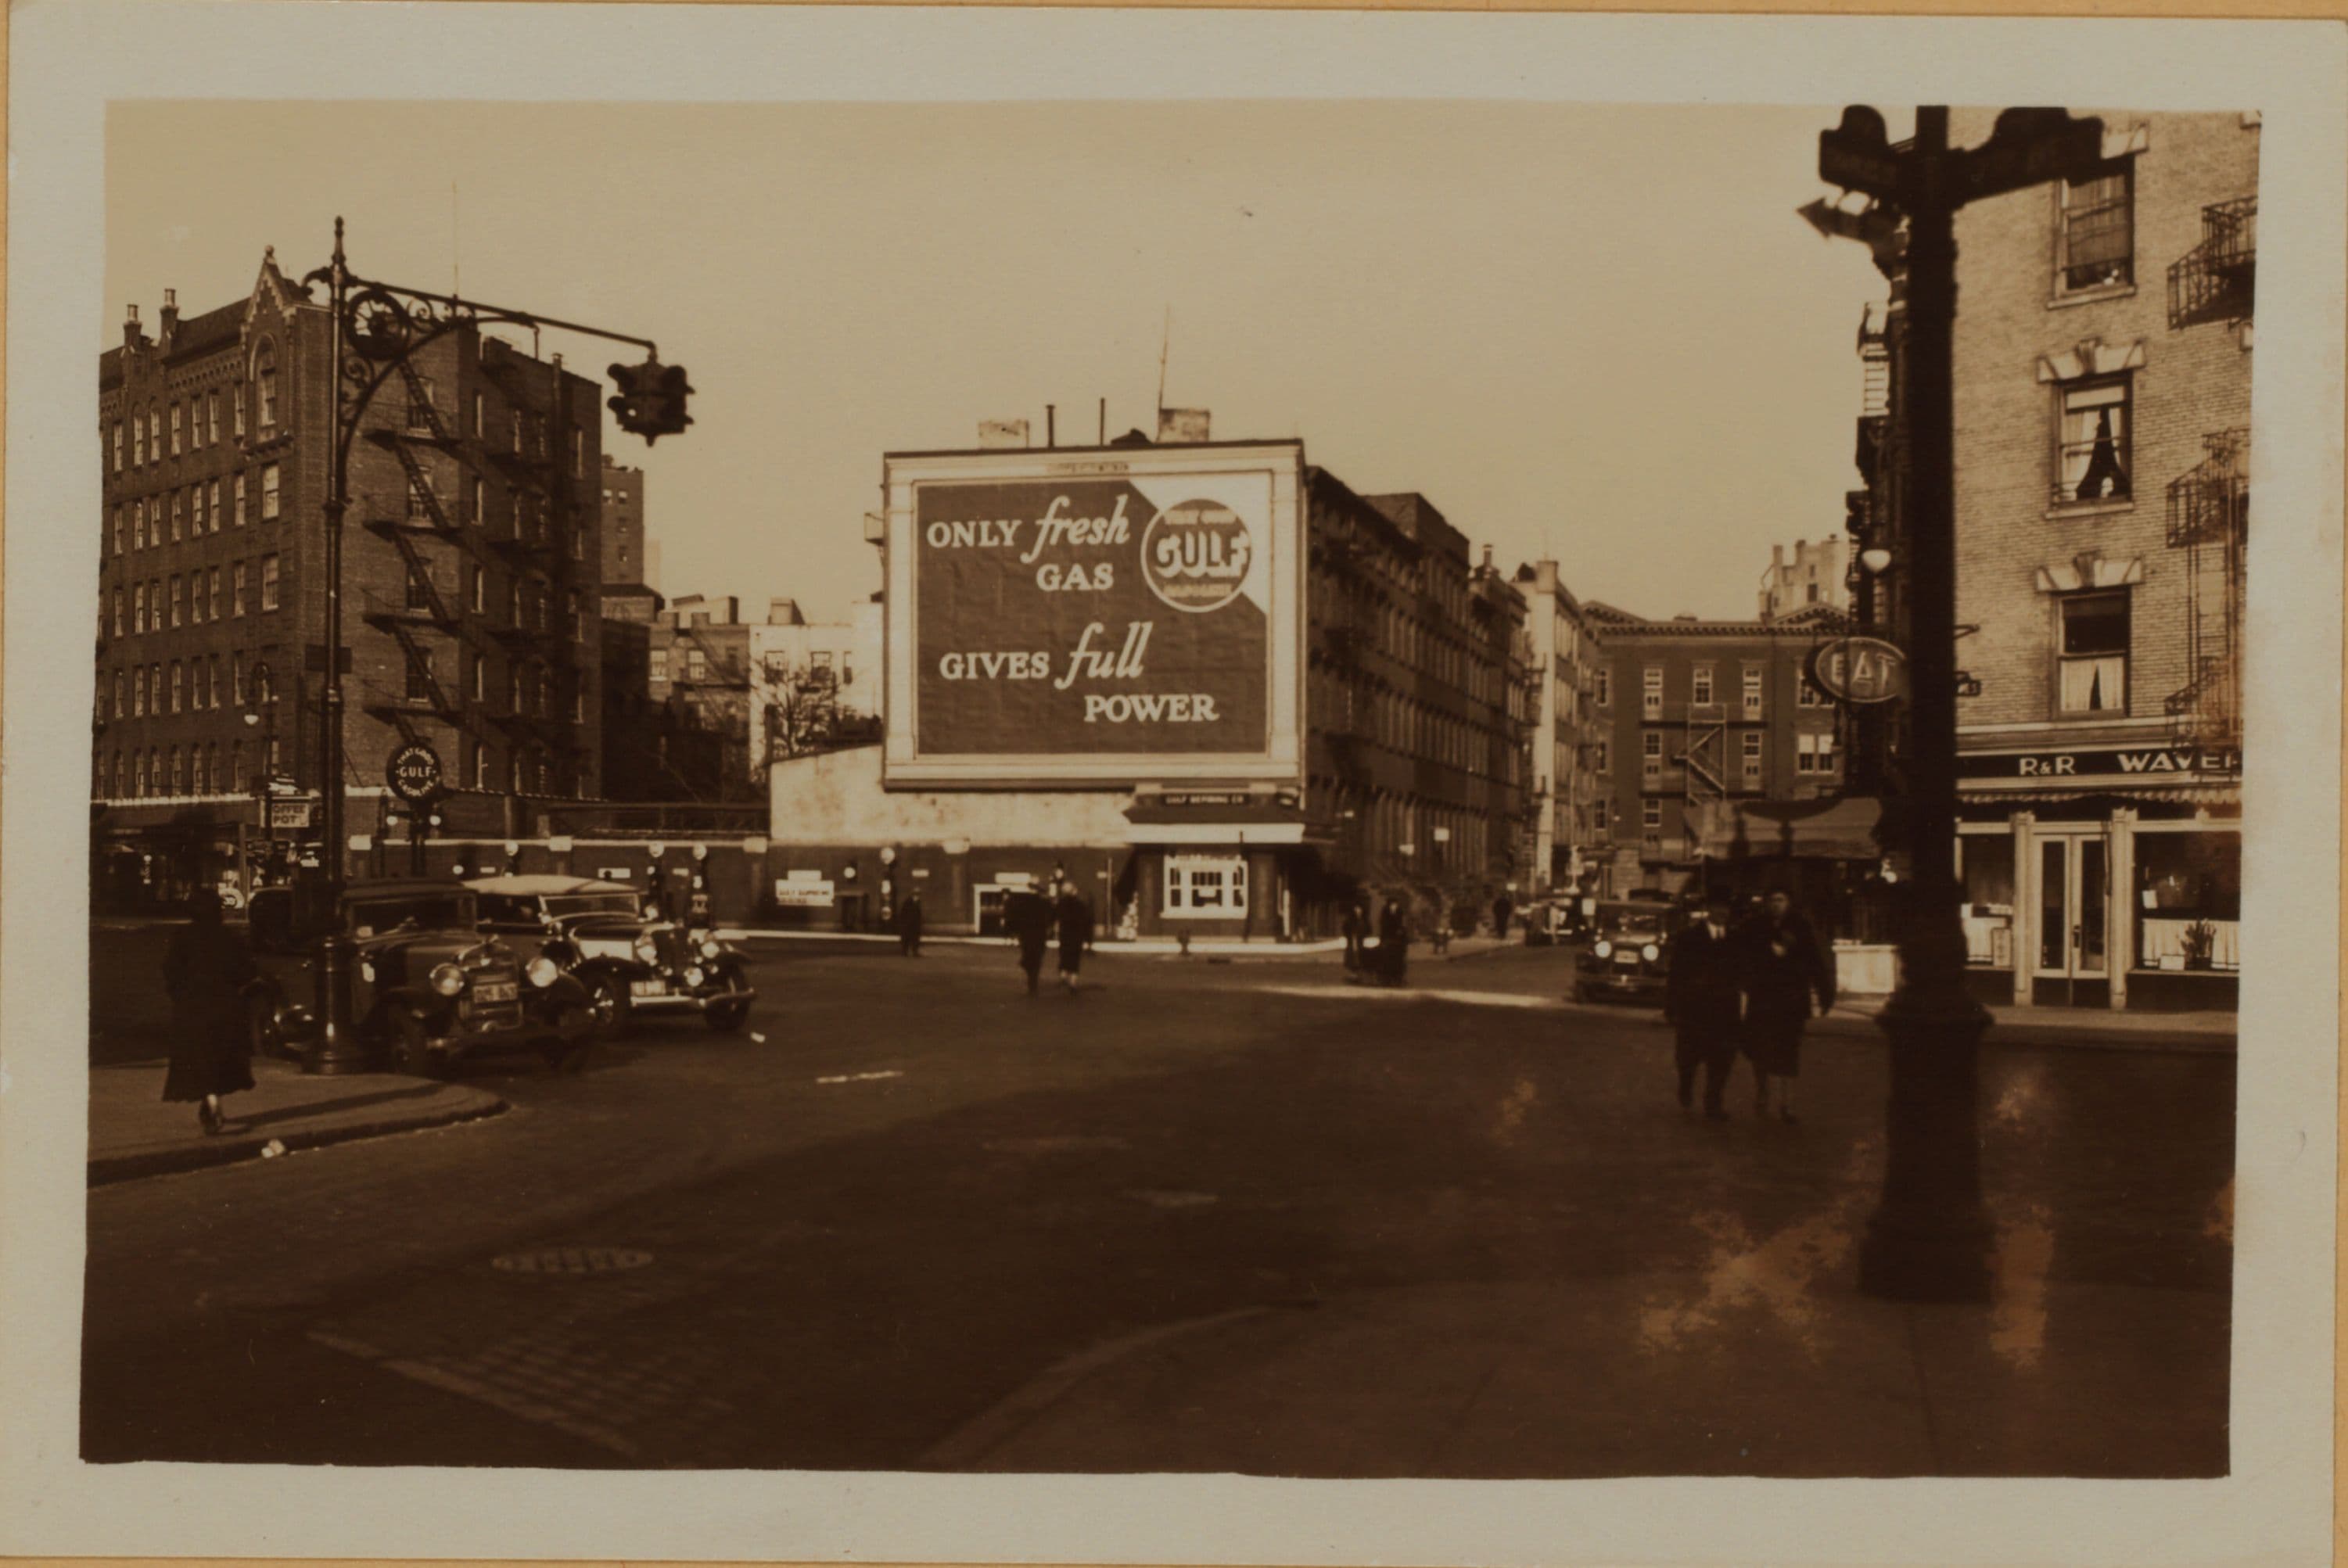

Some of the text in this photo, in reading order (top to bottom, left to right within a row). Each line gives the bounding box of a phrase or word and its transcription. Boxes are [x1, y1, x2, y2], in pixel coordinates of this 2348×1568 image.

[926, 493, 1130, 563] ONLY fresh
[1155, 530, 1250, 578] GULF
[1036, 562, 1115, 591] GAS
[939, 621, 1154, 690] GIVES full
[1830, 650, 1897, 690] EAT
[1084, 693, 1221, 723] POWER
[400, 766, 433, 778] GULF
[2018, 755, 2076, 776] R&R
